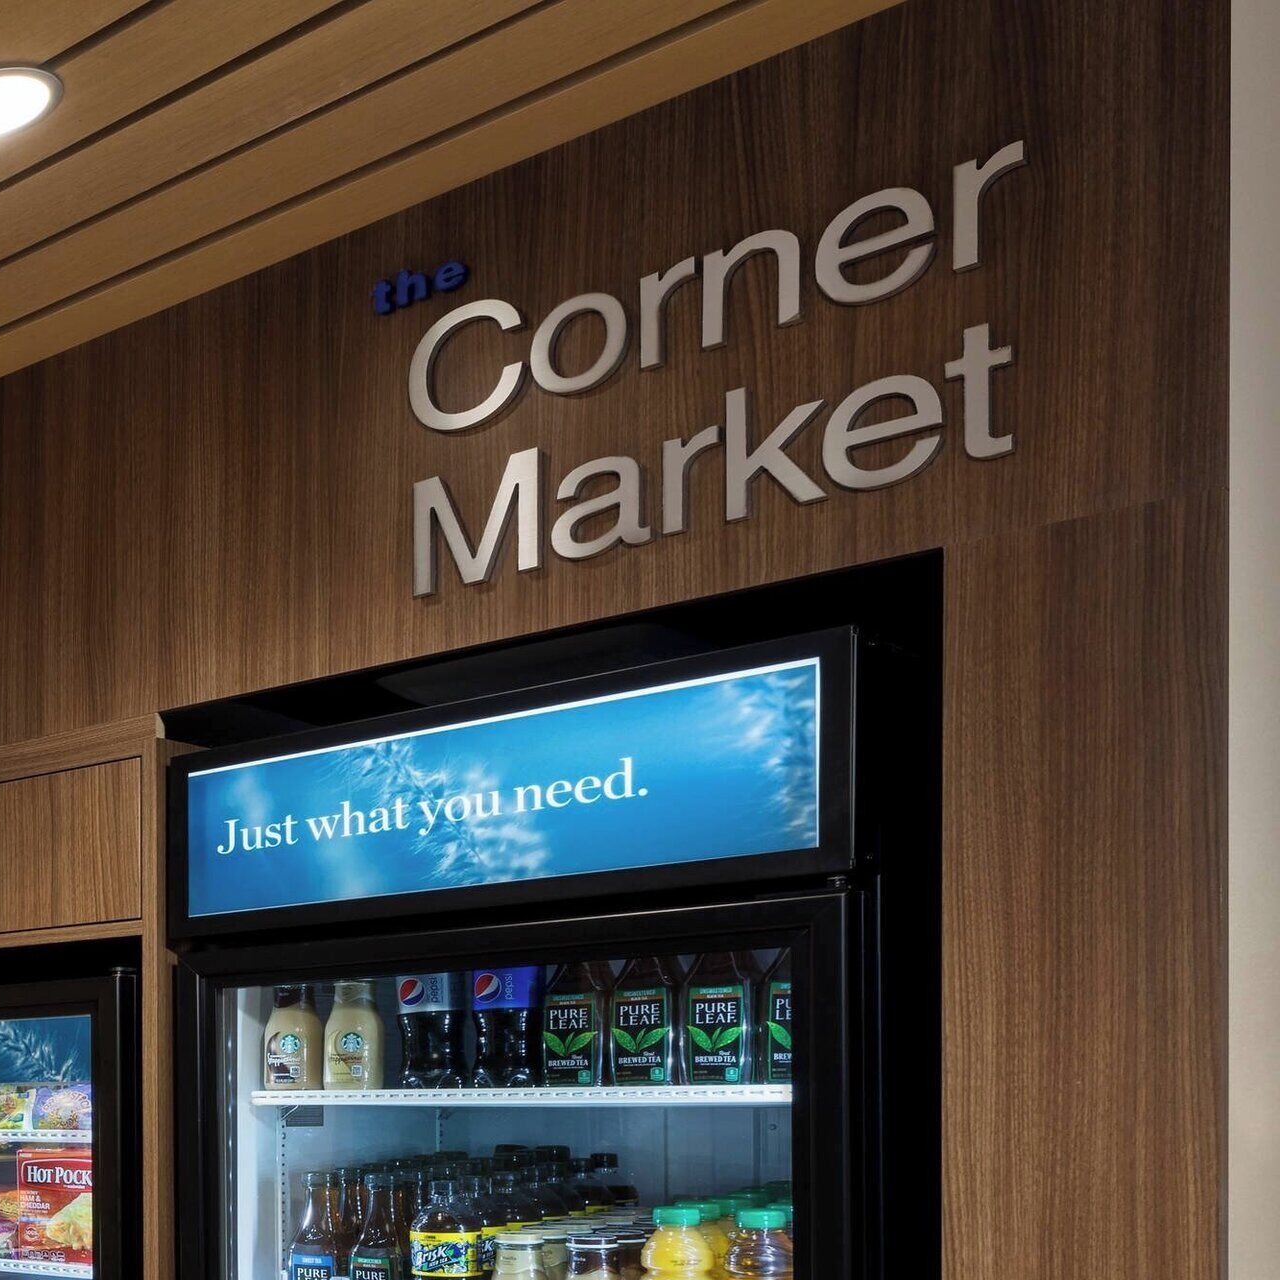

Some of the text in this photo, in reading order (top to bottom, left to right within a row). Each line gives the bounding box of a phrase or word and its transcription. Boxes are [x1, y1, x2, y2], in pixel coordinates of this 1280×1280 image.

[369, 259, 470, 316] the
[409, 140, 1027, 433] Corner
[413, 322, 1016, 599] Market
[216, 757, 650, 857] Just what you need.
[550, 1008, 588, 1019] PURE
[620, 1003, 660, 1015] PURE
[695, 1002, 737, 1013] PURE
[27, 1165, 54, 1184] HOT
[297, 1267, 328, 1278] PURE
[355, 1270, 385, 1280] PURE
